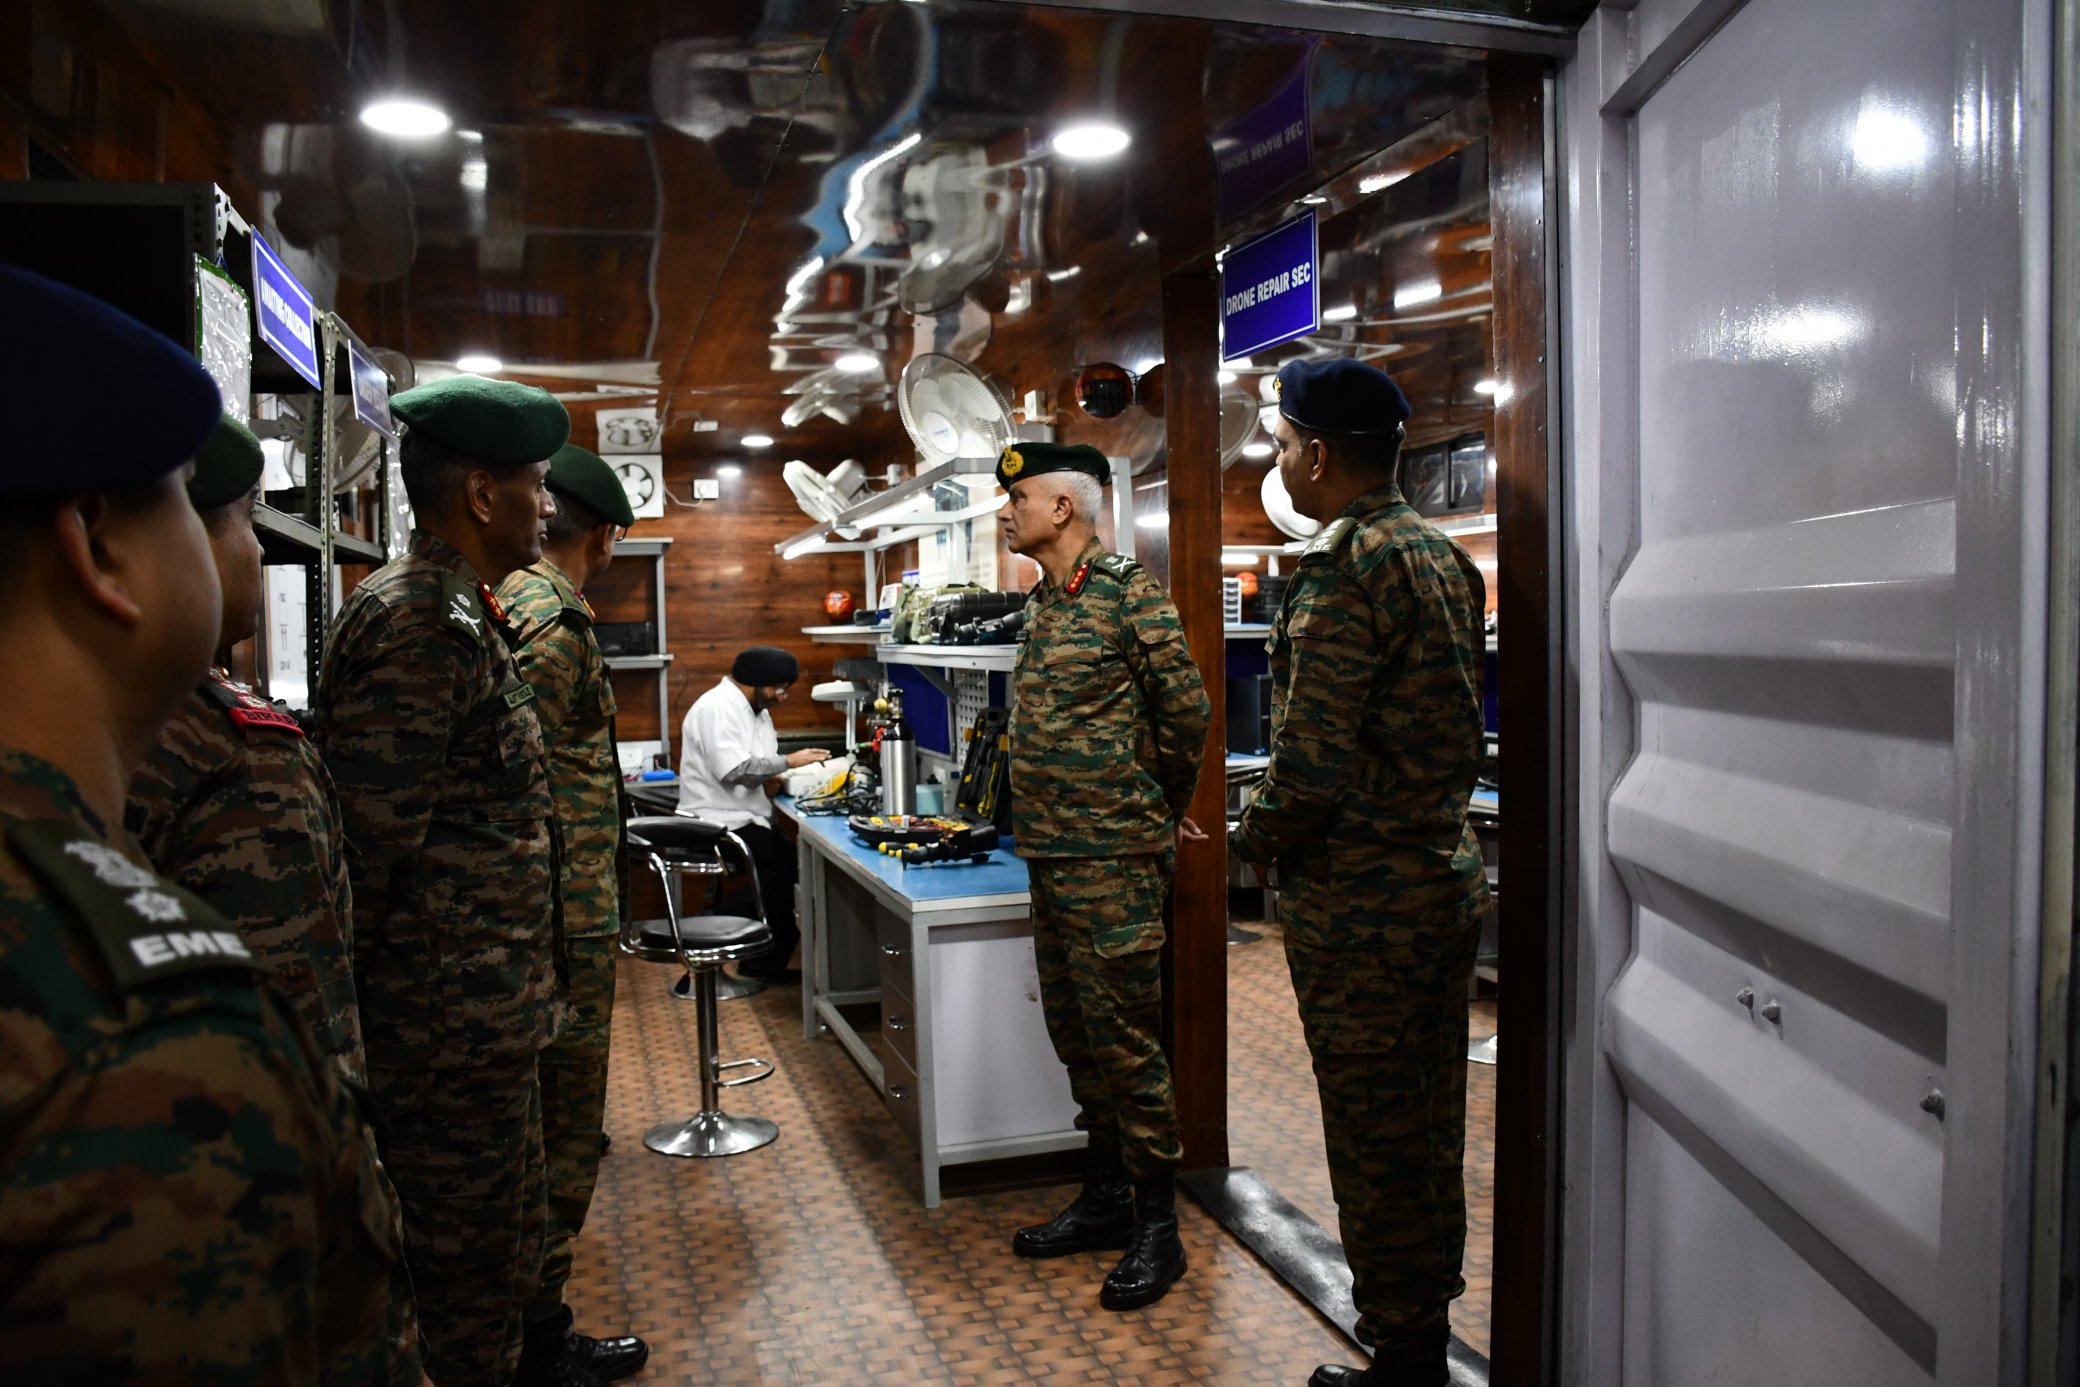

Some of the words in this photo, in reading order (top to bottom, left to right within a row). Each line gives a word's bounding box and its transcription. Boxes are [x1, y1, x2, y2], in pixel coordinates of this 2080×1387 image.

[1226, 286, 1256, 316] DRONE
[1258, 271, 1290, 303] REPAIR
[1291, 262, 1311, 288] SEC
[129, 931, 251, 967] EME
